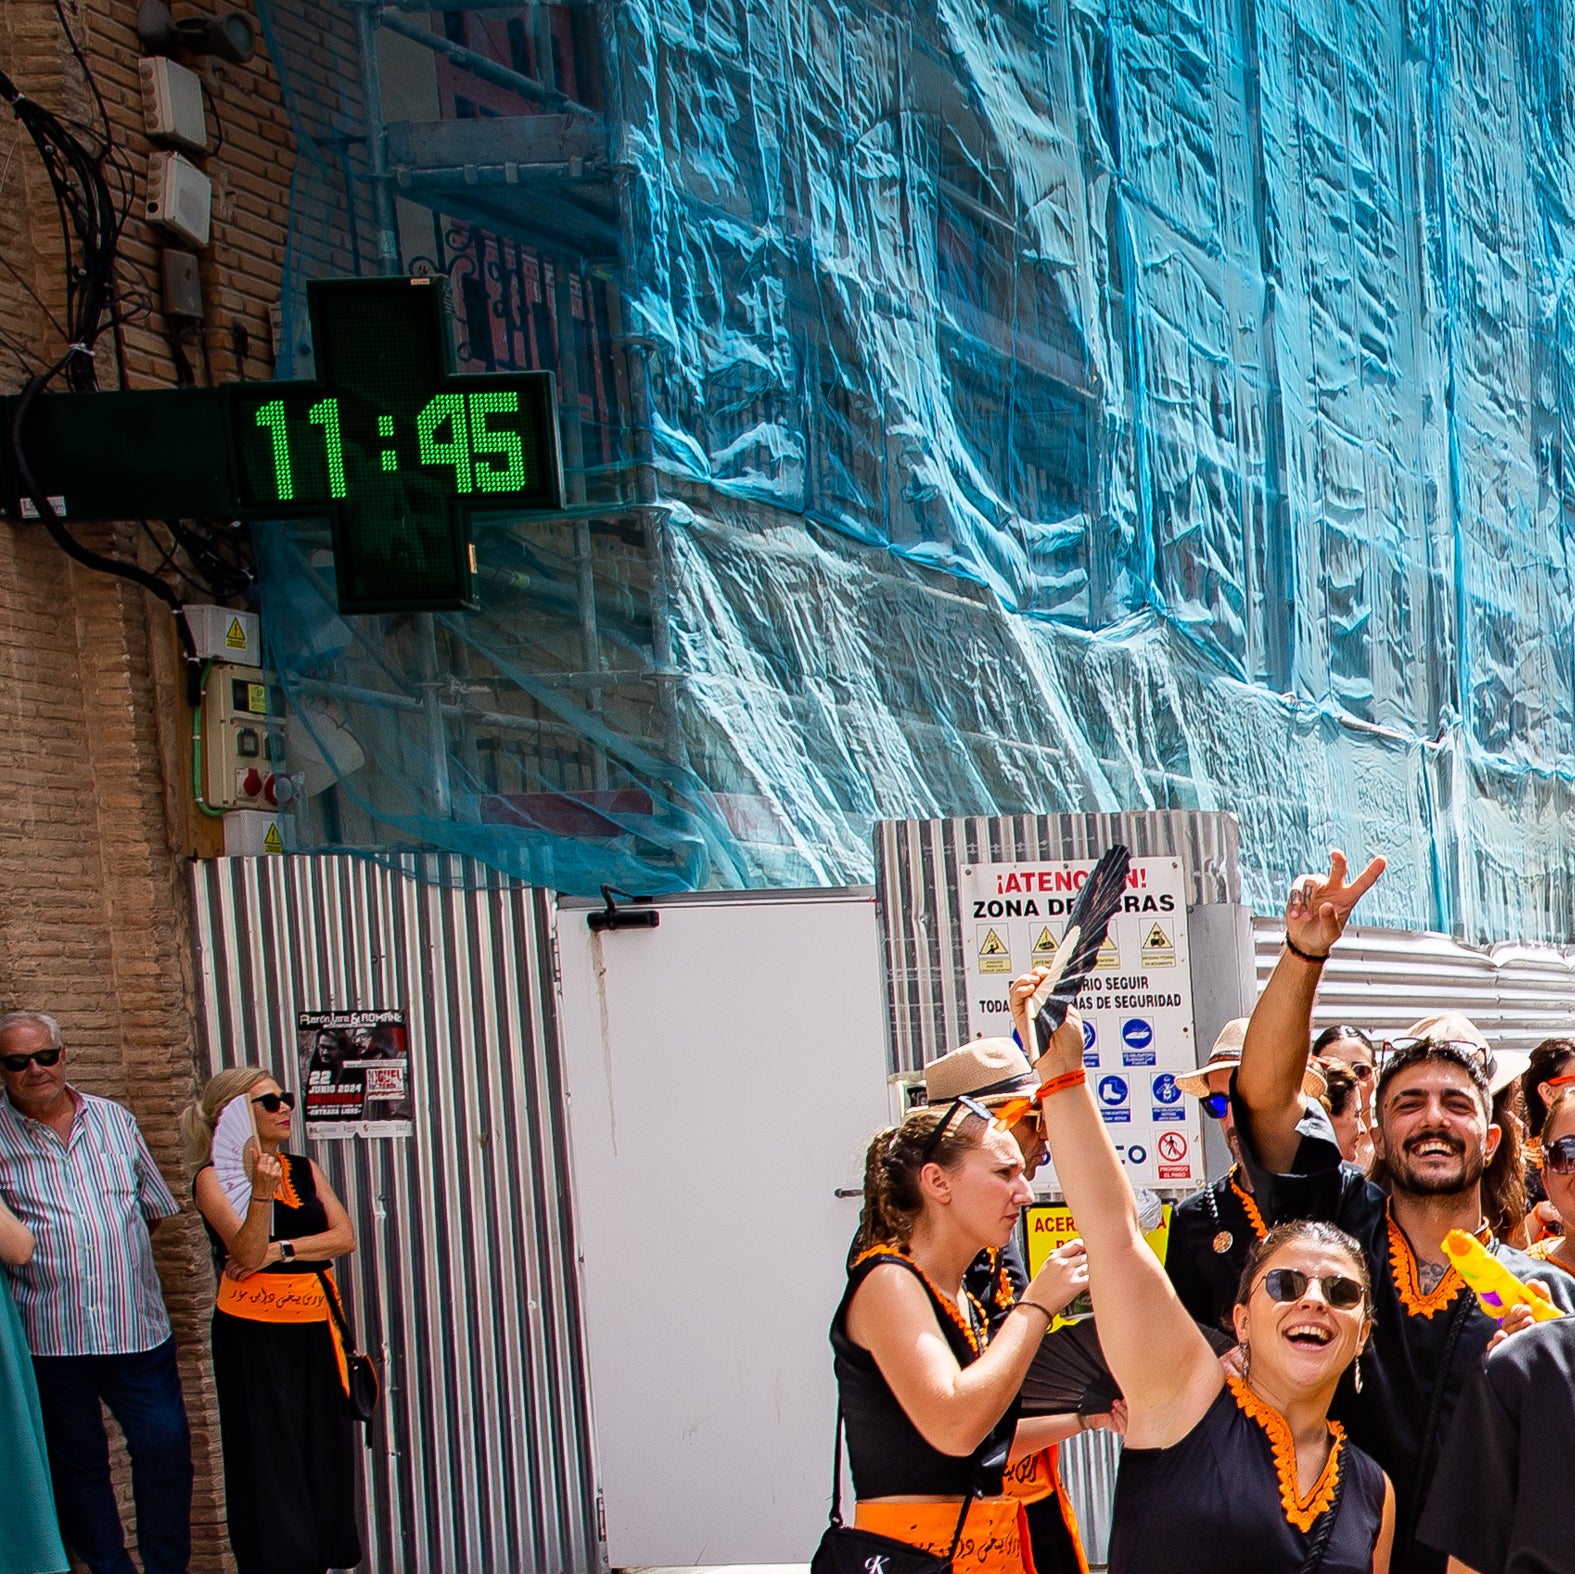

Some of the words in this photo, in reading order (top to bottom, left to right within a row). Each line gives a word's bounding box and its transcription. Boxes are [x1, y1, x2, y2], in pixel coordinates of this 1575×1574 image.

[256, 391, 526, 500] 11:45
[997, 868, 1147, 894] ¡ATENCN!
[973, 900, 1040, 918] ZONA
[1106, 976, 1149, 990] SEGUIR
[1097, 996, 1113, 1009] DE
[1115, 993, 1182, 1008] SEGURIDAD
[308, 1070, 332, 1085] 22
[338, 1083, 362, 1093] 2024
